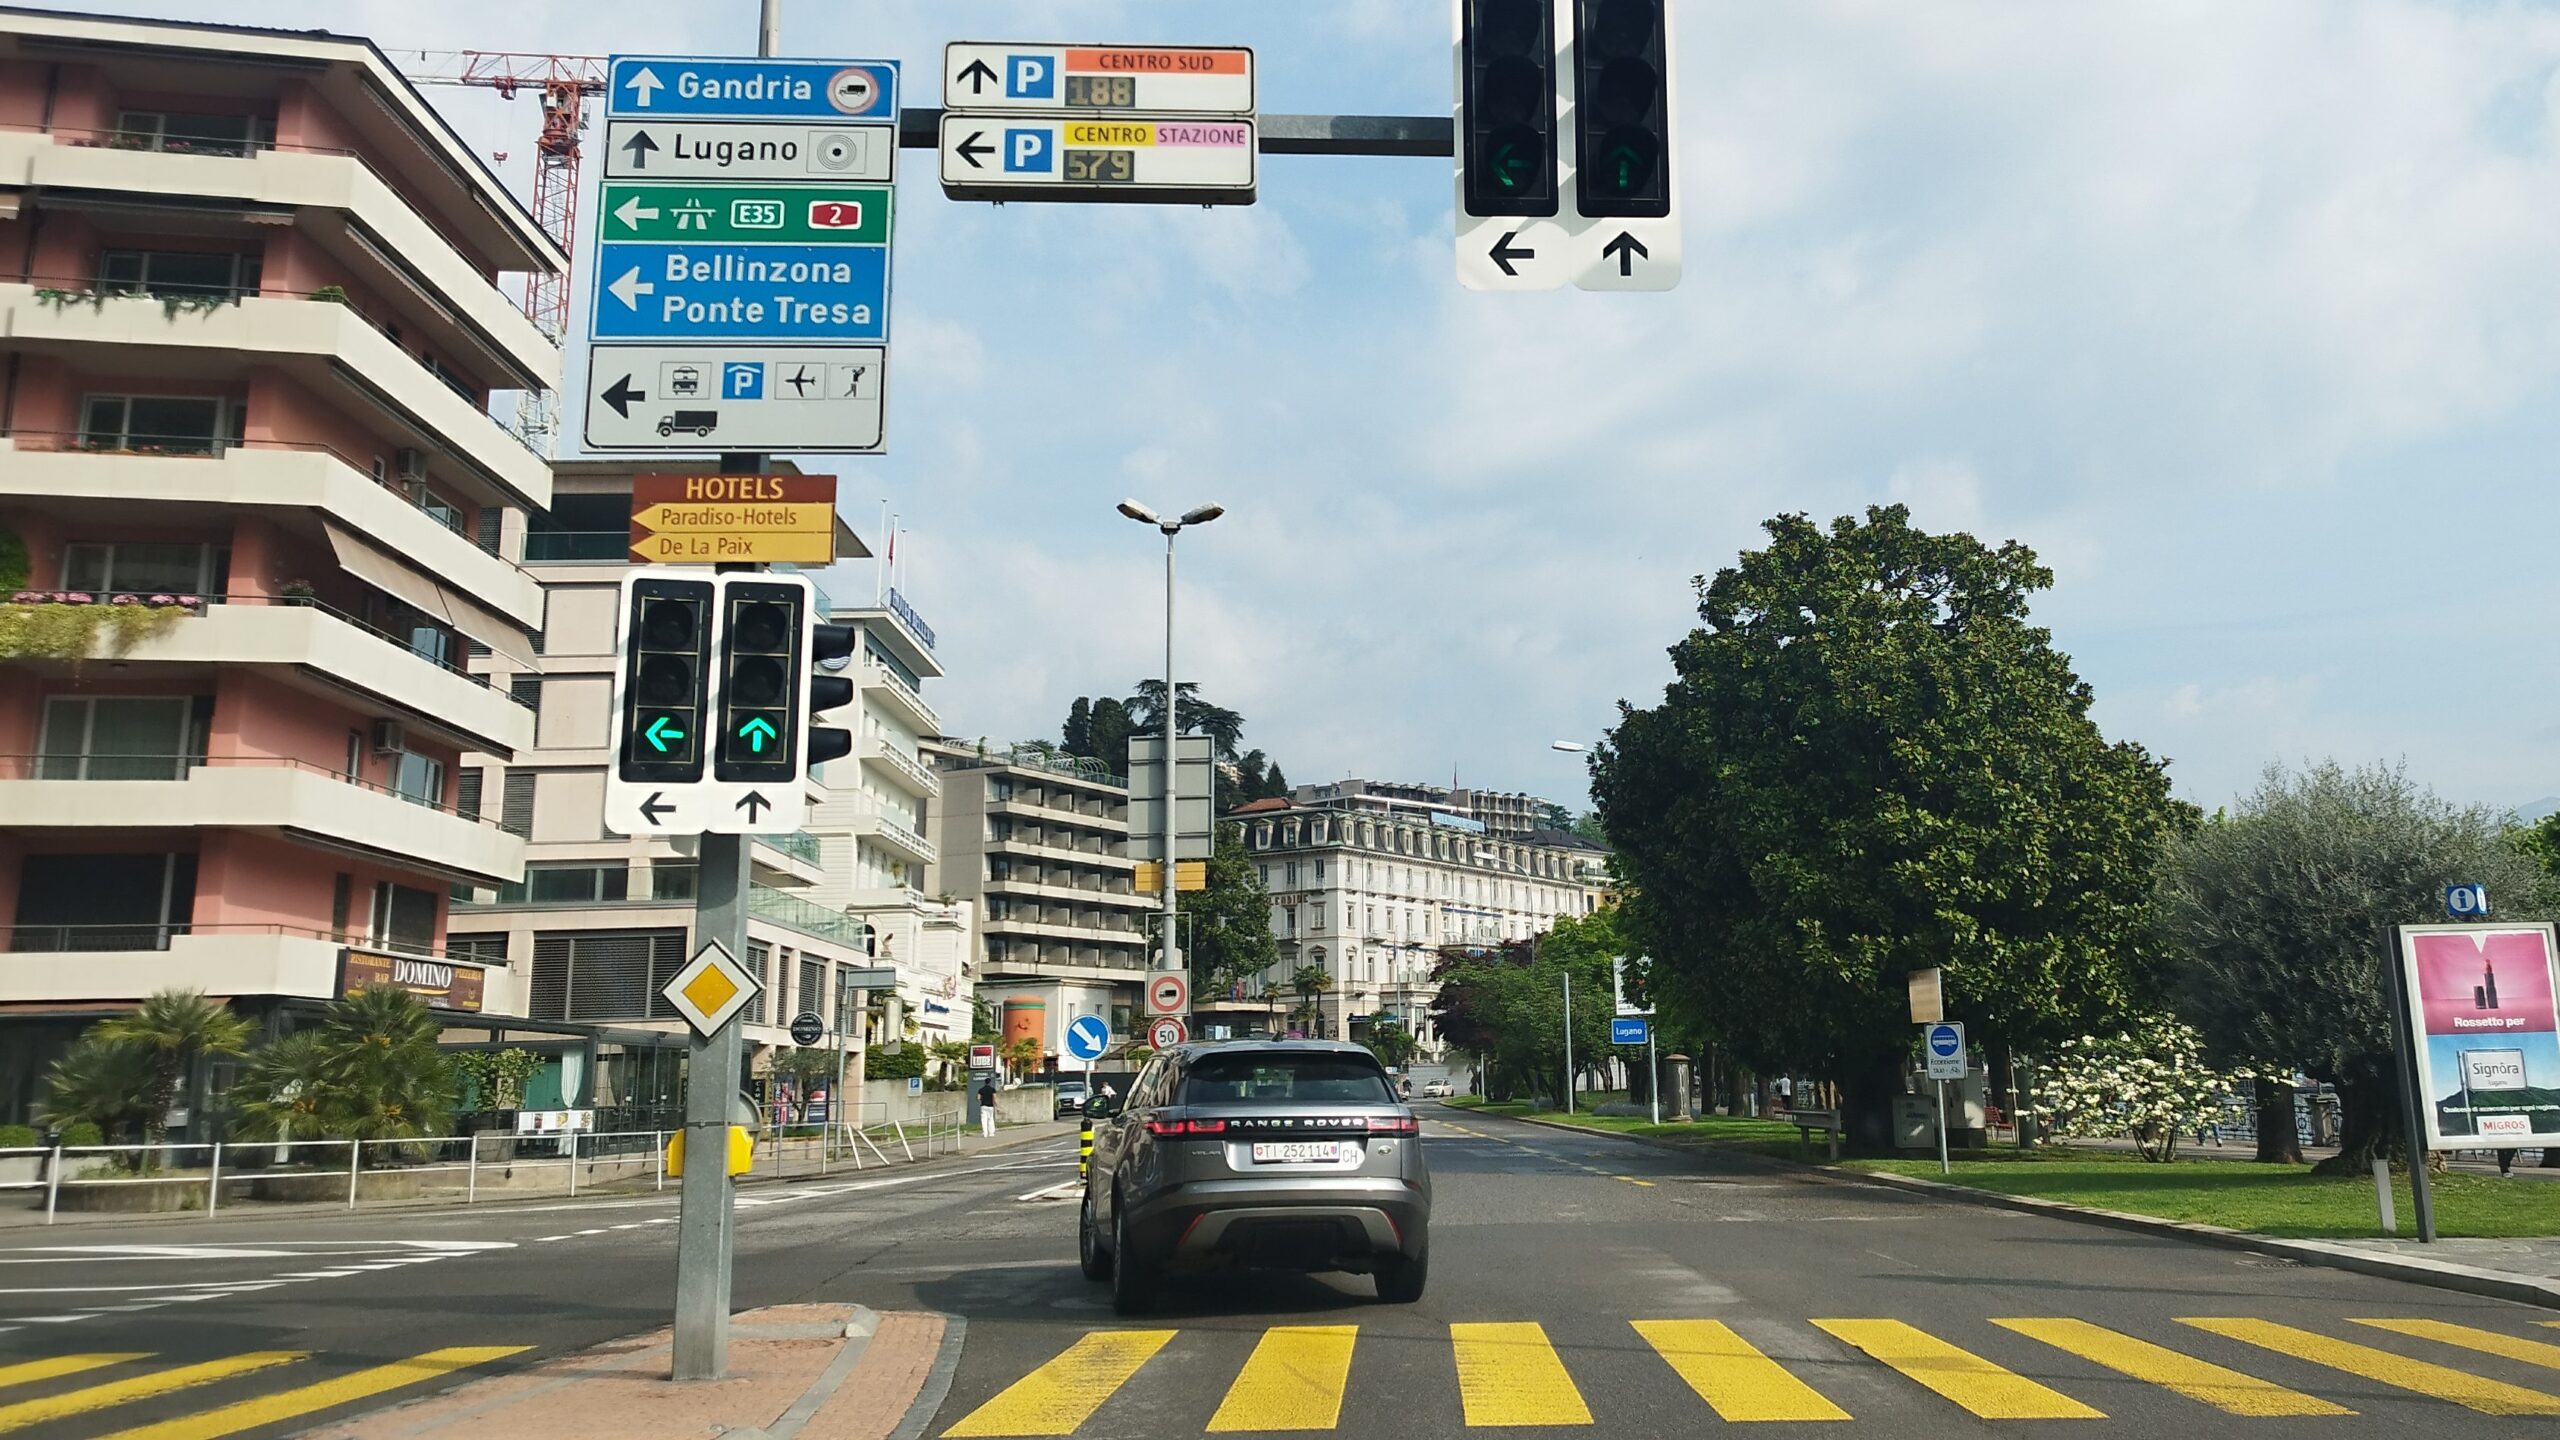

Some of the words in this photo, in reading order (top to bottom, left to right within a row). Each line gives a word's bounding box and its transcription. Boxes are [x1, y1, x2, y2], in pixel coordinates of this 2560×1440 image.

[1099, 53, 1171, 69] CENTRO
[1178, 55, 1214, 71] SUD
[677, 71, 812, 100] Gandria
[1016, 60, 1044, 93] P
[1069, 78, 1131, 106] 188
[1074, 126, 1146, 142] CENTRO
[1159, 128, 1246, 145] STAZIONE
[674, 132, 798, 167] Lugano
[1014, 134, 1042, 167] P
[1068, 152, 1131, 180] 579
[739, 205, 775, 224] E35
[829, 206, 841, 224] 2
[665, 253, 851, 284] Bellinzona
[662, 296, 764, 324] Ponte
[773, 296, 871, 325] Tresa
[686, 477, 784, 500] HOTELS
[661, 507, 797, 526] Paradiso-Hotels
[660, 538, 683, 555] De
[691, 538, 709, 555] La
[717, 536, 752, 555] Paix
[350, 953, 391, 968] RISTORANTE
[374, 972, 389, 983] BAR
[394, 960, 452, 988] DOMINO
[455, 967, 482, 981] PIZZERIA
[1616, 1027, 1642, 1036] Lugano
[2454, 1017, 2504, 1028] Rossetto
[2506, 1017, 2525, 1028] per
[1160, 1030, 1174, 1043] 50
[1304, 1118, 1364, 1126] ROVER
[2483, 1121, 2525, 1130] MIGROS
[1343, 1149, 1358, 1163] CH
